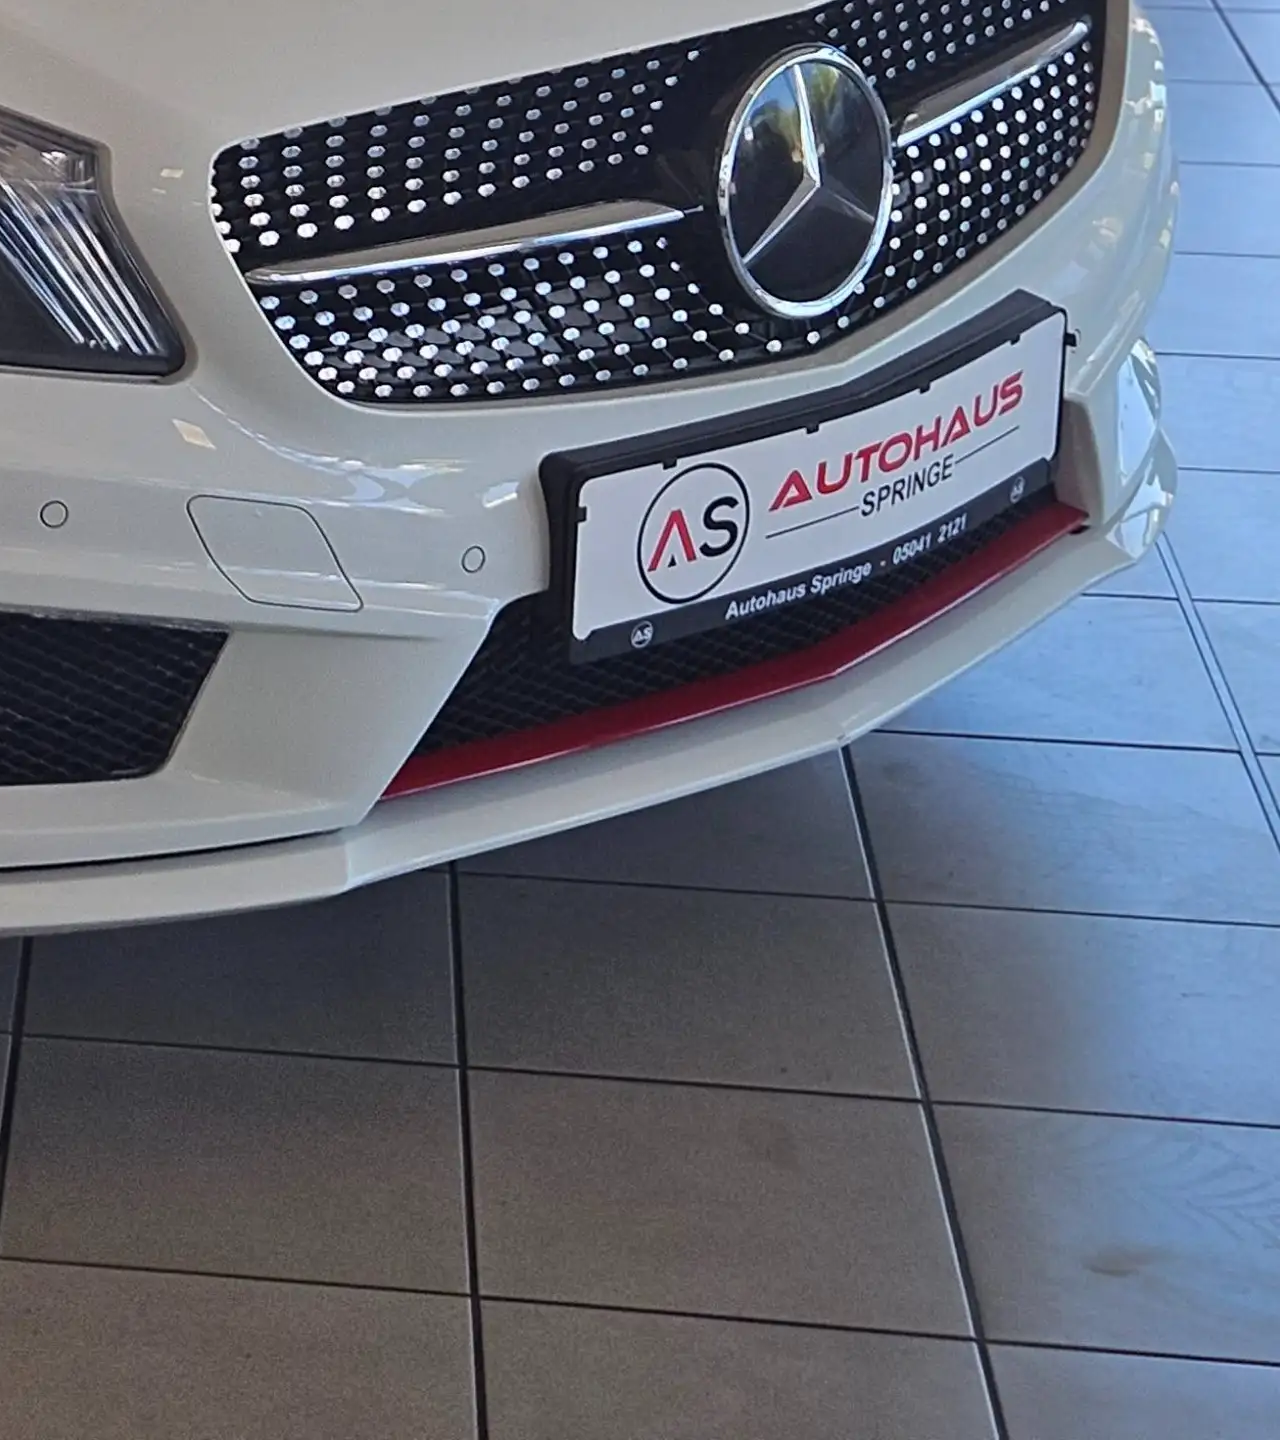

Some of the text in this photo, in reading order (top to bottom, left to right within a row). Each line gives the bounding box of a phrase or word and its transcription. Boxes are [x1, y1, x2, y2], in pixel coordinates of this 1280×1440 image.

[768, 370, 1025, 512] AUTOHAUS
[860, 453, 955, 517] SPRINGE
[647, 495, 740, 573] AS
[724, 582, 806, 621] Autohaus
[810, 561, 873, 596] Springe
[891, 532, 933, 565] 05041
[936, 512, 969, 543] 2121
